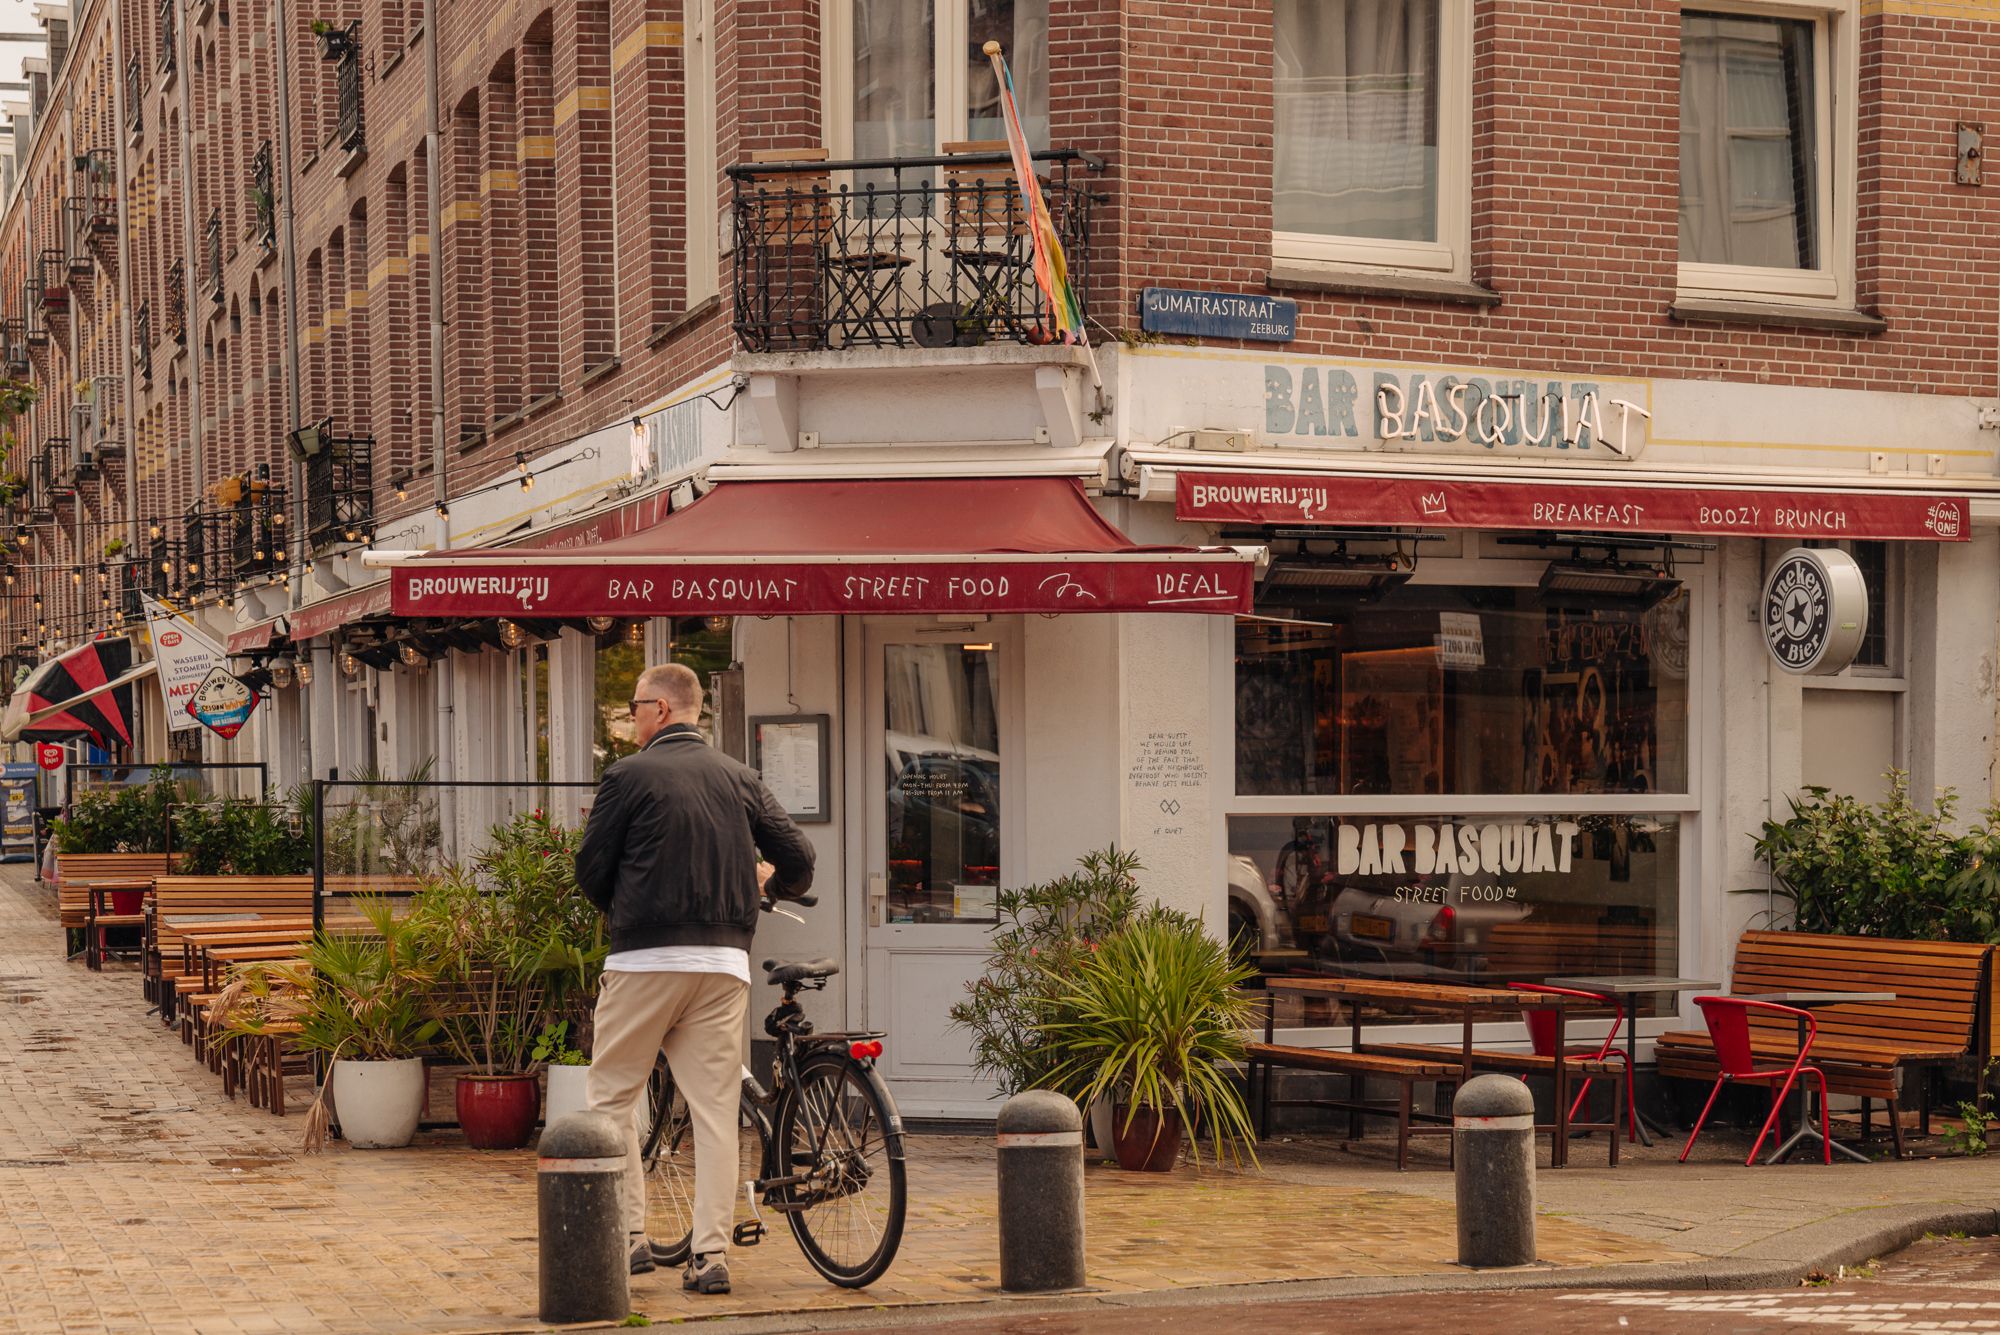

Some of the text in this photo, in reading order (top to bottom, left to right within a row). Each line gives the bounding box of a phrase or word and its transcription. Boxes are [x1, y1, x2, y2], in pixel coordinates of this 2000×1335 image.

[1250, 323, 1290, 336] ZEEBURG
[1265, 365, 1359, 437] BAR
[1377, 380, 1651, 455] BASQUIAT
[1193, 485, 1297, 508] BROUWERIJ
[1533, 503, 1644, 525] BREAKFAST
[1700, 506, 1846, 529] BOOZY BRUNCH
[409, 577, 515, 600] BROUWERIJ
[608, 578, 797, 601] BAR BASQUIAT
[843, 576, 1009, 600] STREET FOOD
[1156, 573, 1228, 594] IDEAL
[1768, 561, 1825, 647] Heineken's
[162, 633, 179, 641] OPEN
[1787, 633, 1820, 661] Bier
[173, 653, 209, 665] WASSERIJ
[174, 662, 211, 674] STOMERIJ
[169, 682, 201, 698] MED
[199, 675, 234, 701] BROUWERIJ
[1162, 780, 1178, 788] GETS
[1338, 822, 1580, 876] BAR BASQUIAT
[1393, 886, 1504, 904] STREET FOOD
